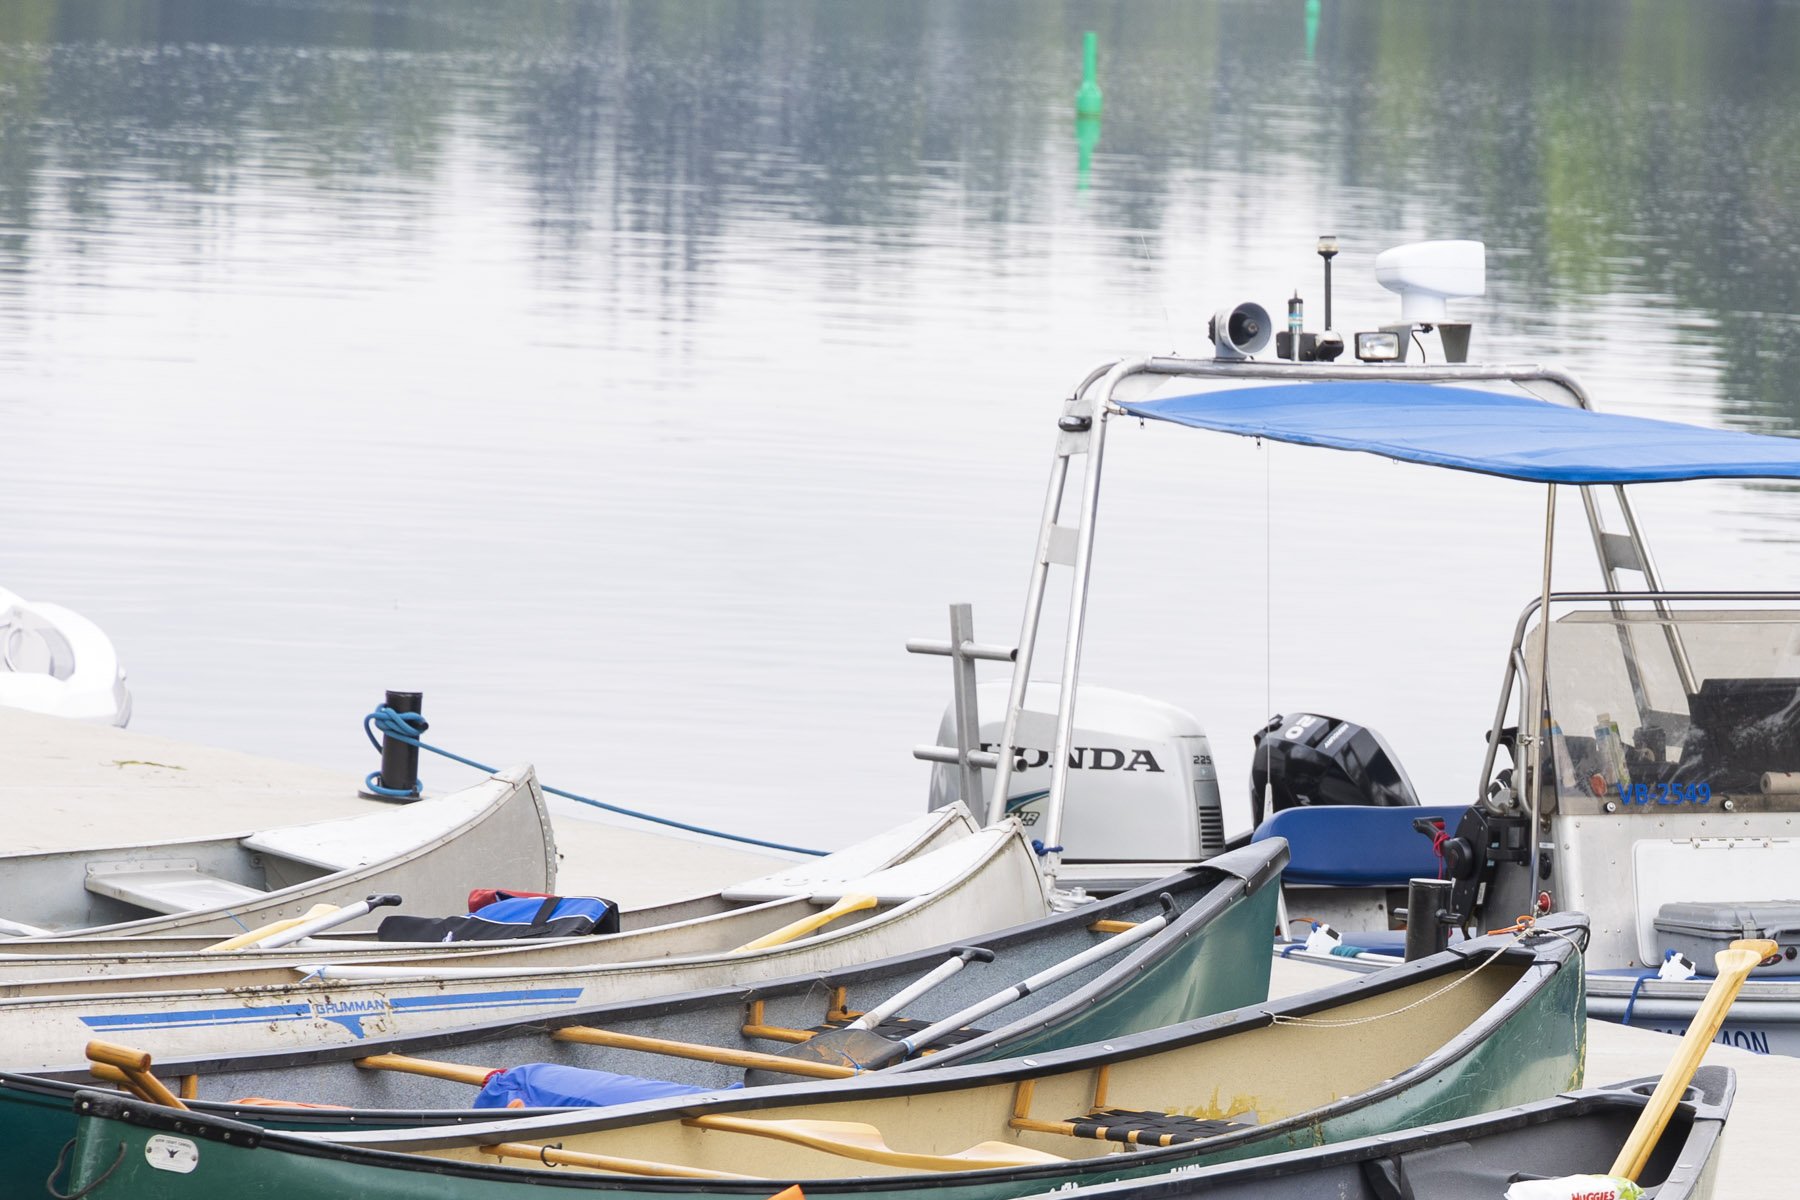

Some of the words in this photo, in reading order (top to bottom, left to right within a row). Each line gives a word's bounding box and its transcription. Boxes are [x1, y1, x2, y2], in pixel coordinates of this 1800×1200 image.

[1193, 755, 1212, 765] 225
[1616, 783, 1713, 806] VB-2549
[315, 999, 386, 1015] GRUMMAN
